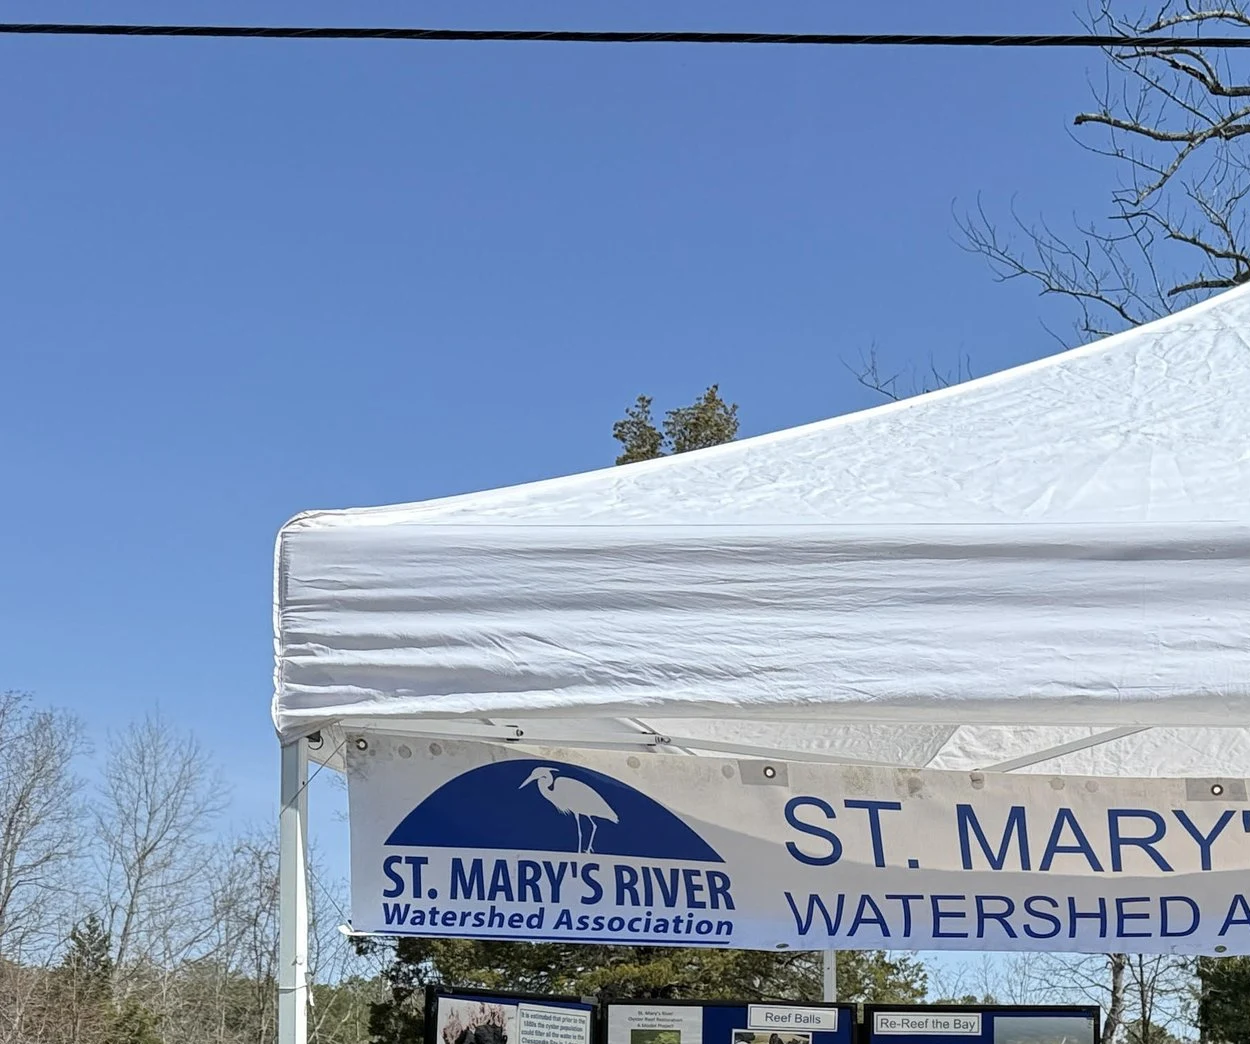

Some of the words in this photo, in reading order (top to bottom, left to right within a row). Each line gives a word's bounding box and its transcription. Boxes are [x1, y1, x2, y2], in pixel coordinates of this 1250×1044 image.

[783, 796, 920, 868] ST.
[382, 855, 438, 900] ST.
[449, 857, 604, 905] MARY'S
[613, 864, 736, 911] RIVER
[382, 902, 546, 930] Watershed
[552, 909, 735, 937] Association
[783, 891, 1201, 939] WATERSHED
[765, 1012, 792, 1023] Reef
[794, 1013, 821, 1025] Balls
[880, 1017, 930, 1030] Re-Reef
[932, 1018, 950, 1029] the
[953, 1018, 976, 1032] Bay
